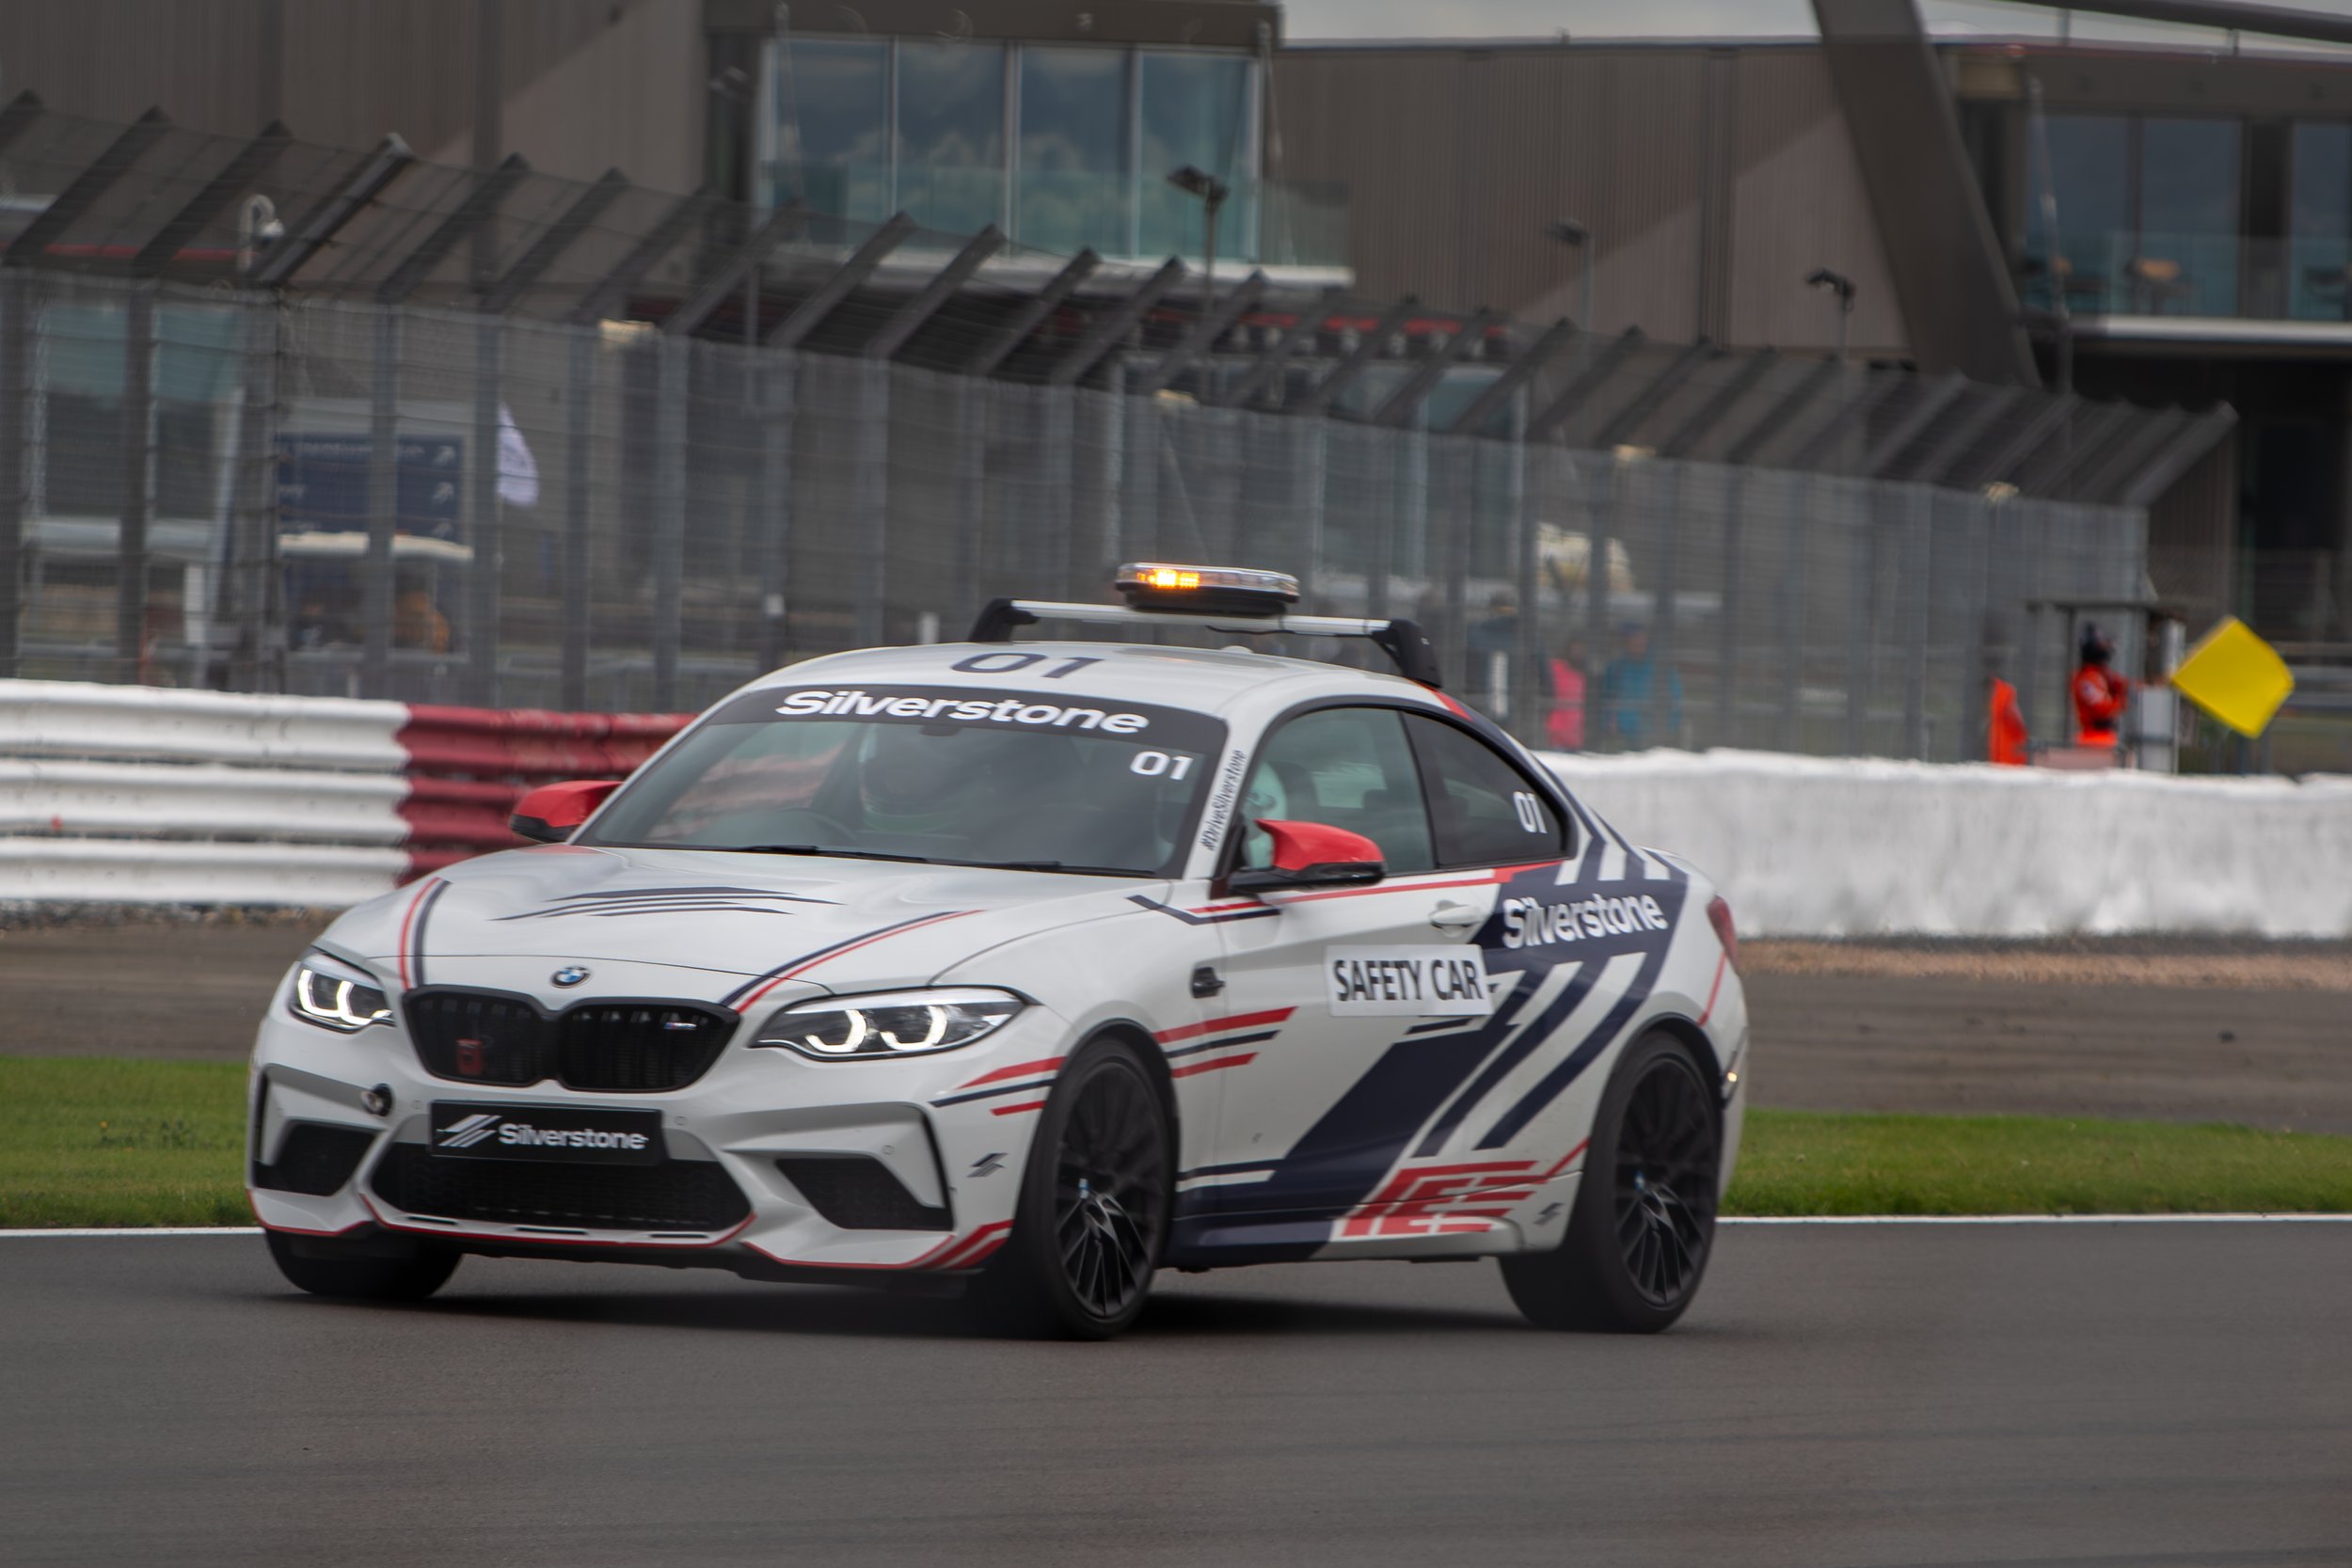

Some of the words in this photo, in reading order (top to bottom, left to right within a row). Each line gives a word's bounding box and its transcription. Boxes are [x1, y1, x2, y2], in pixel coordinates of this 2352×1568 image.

[949, 652, 1105, 678] 01
[775, 690, 1150, 734] Silverstone
[1130, 751, 1193, 781] 01
[1200, 749, 1247, 851] #DriveSilverstone
[1513, 791, 1548, 834] 01
[1502, 894, 1669, 949] Silverstone
[1332, 959, 1422, 1001] SAFETY
[1430, 959, 1485, 1001] CAR
[498, 1123, 649, 1149] Silverstone
